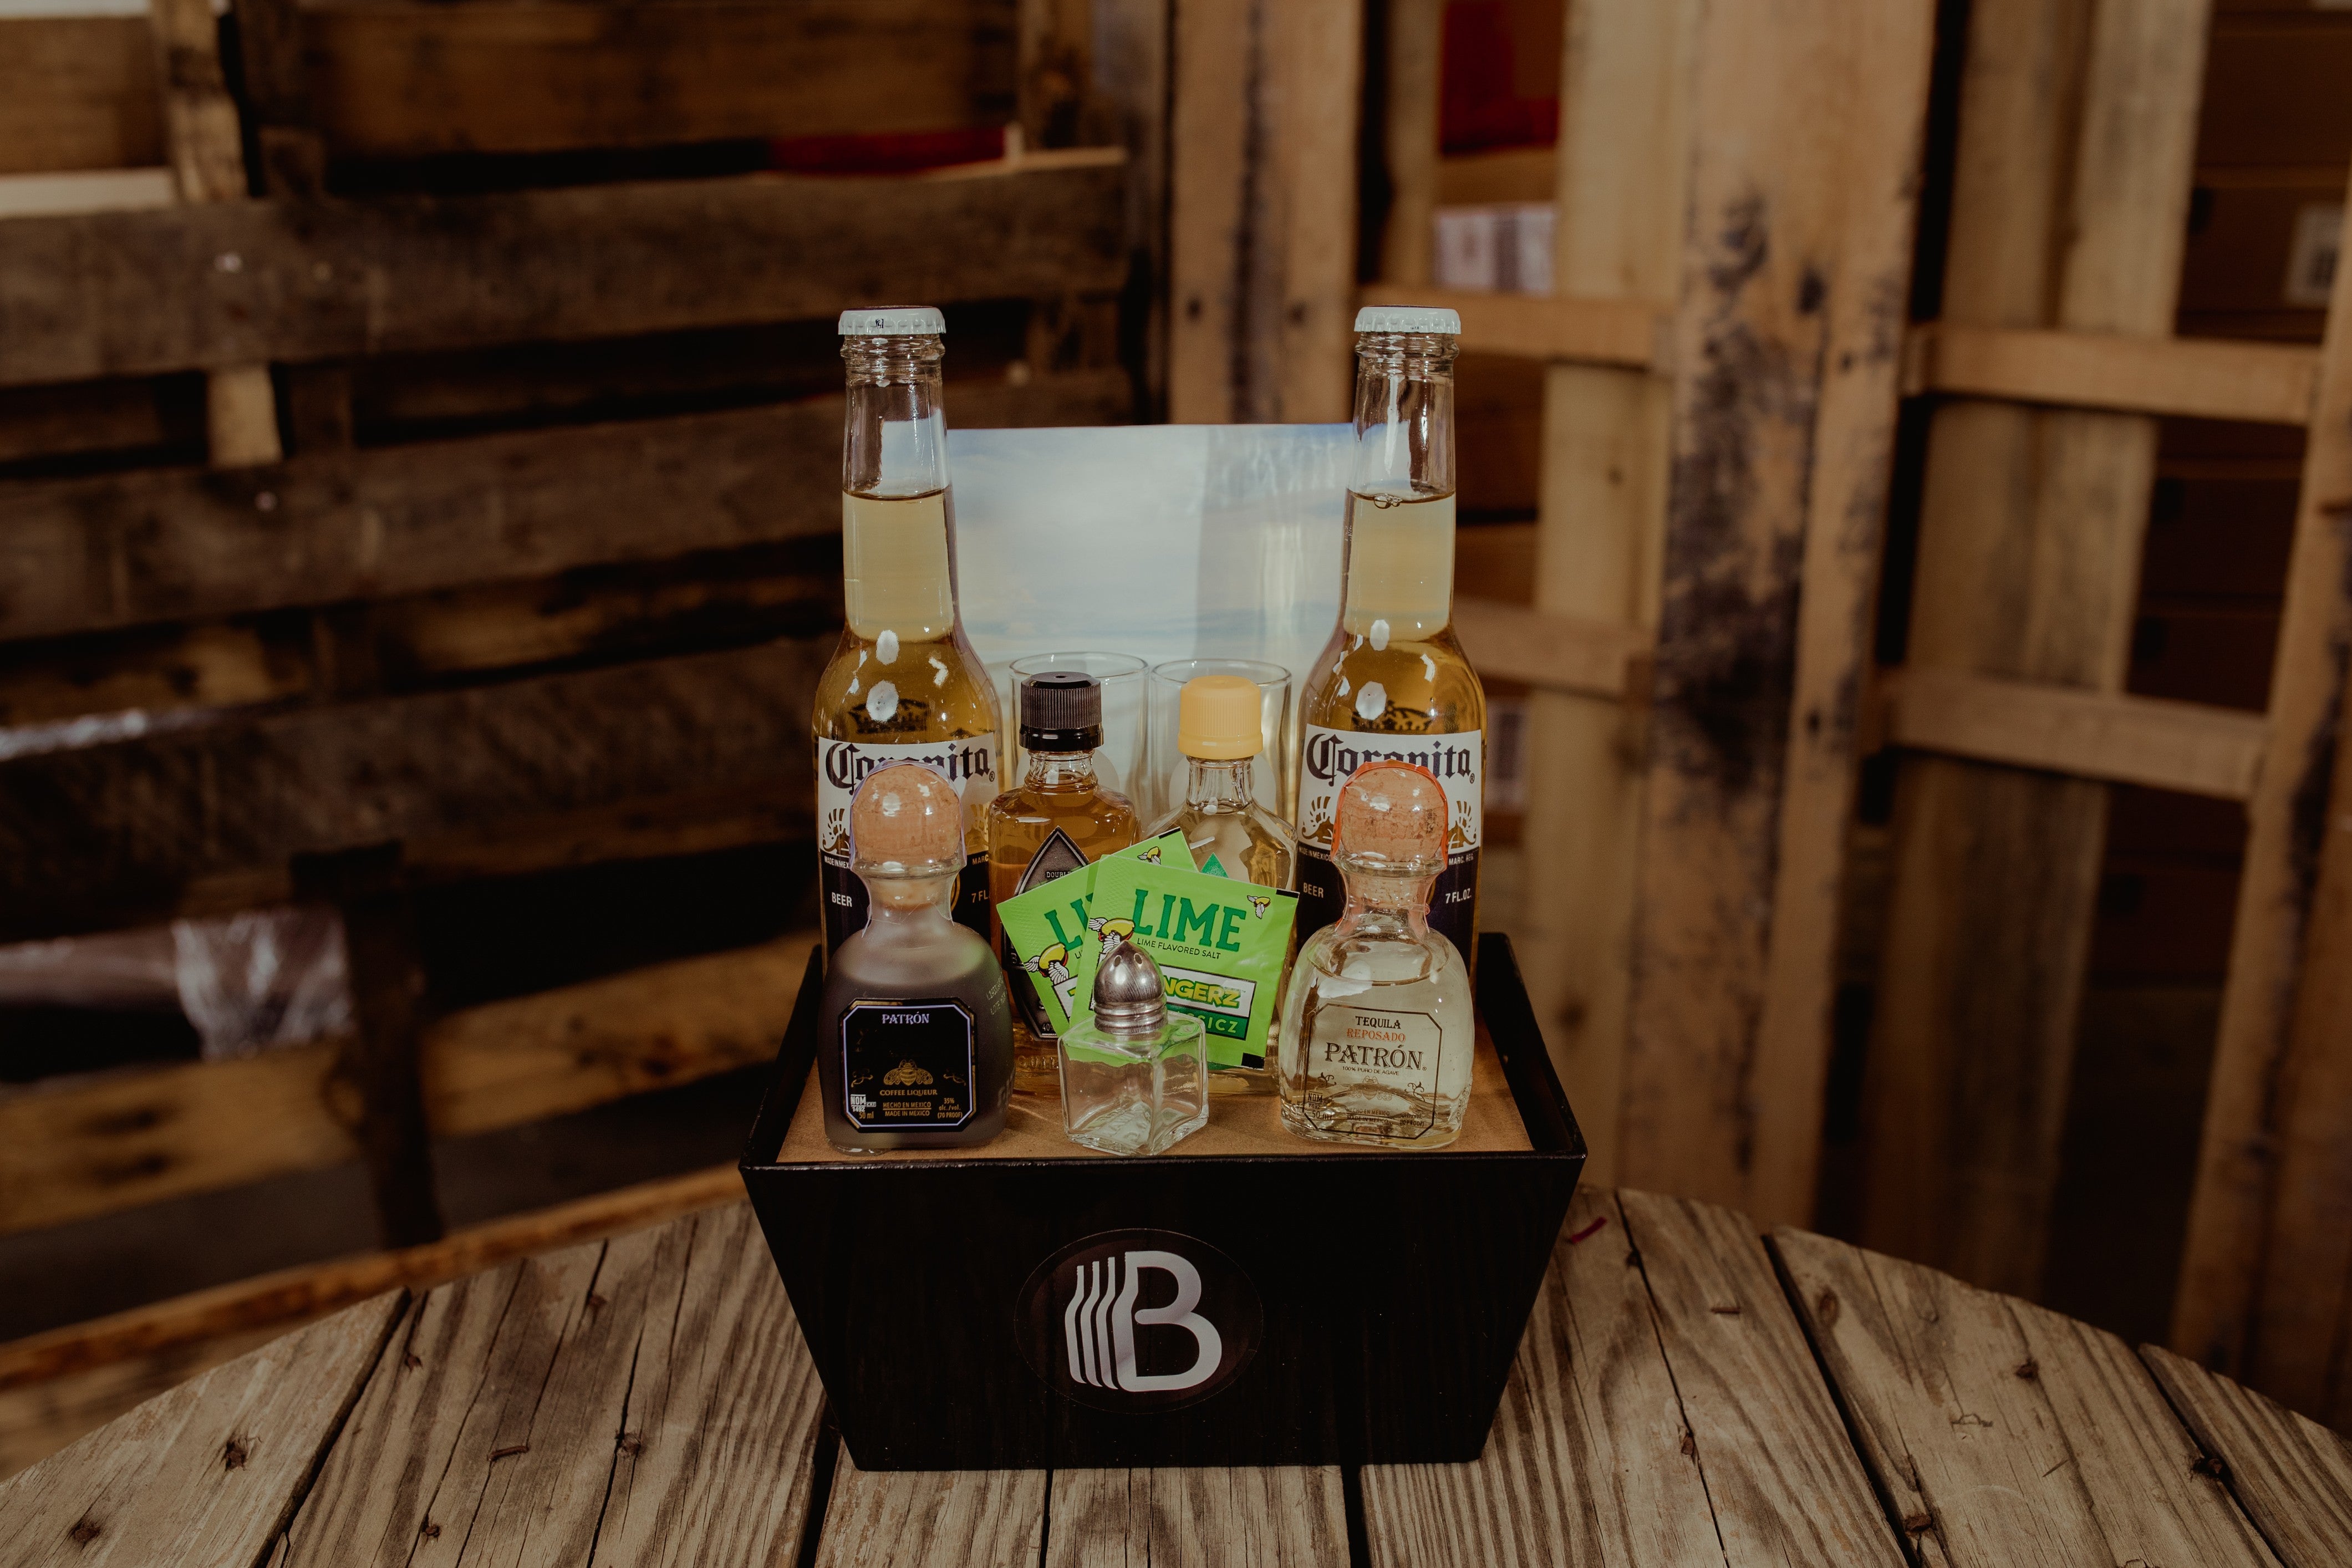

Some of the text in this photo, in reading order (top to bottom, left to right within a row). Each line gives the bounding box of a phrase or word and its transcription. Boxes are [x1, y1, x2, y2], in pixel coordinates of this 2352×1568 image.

[826, 743, 990, 795] Coita
[824, 856, 834, 866] MADE
[839, 860, 851, 869] MEX
[1303, 882, 1324, 898] BEER
[832, 892, 853, 907] BEER
[971, 893, 976, 903] 7
[1445, 893, 1451, 904] 7
[1044, 892, 1093, 951] LI
[1131, 888, 1246, 952] LIME
[1137, 938, 1221, 959] LIME FLAVORED SALT
[1164, 975, 1241, 1009] NGERZ
[882, 1011, 929, 1025] PATRÓN
[1355, 1016, 1402, 1030] TEQUILA
[1346, 1028, 1406, 1043] REPOSADO
[1325, 1042, 1424, 1071] PATRÓN
[851, 1096, 866, 1105] NOM
[1309, 1092, 1323, 1103] NOM
[1312, 1110, 1320, 1119] 50
